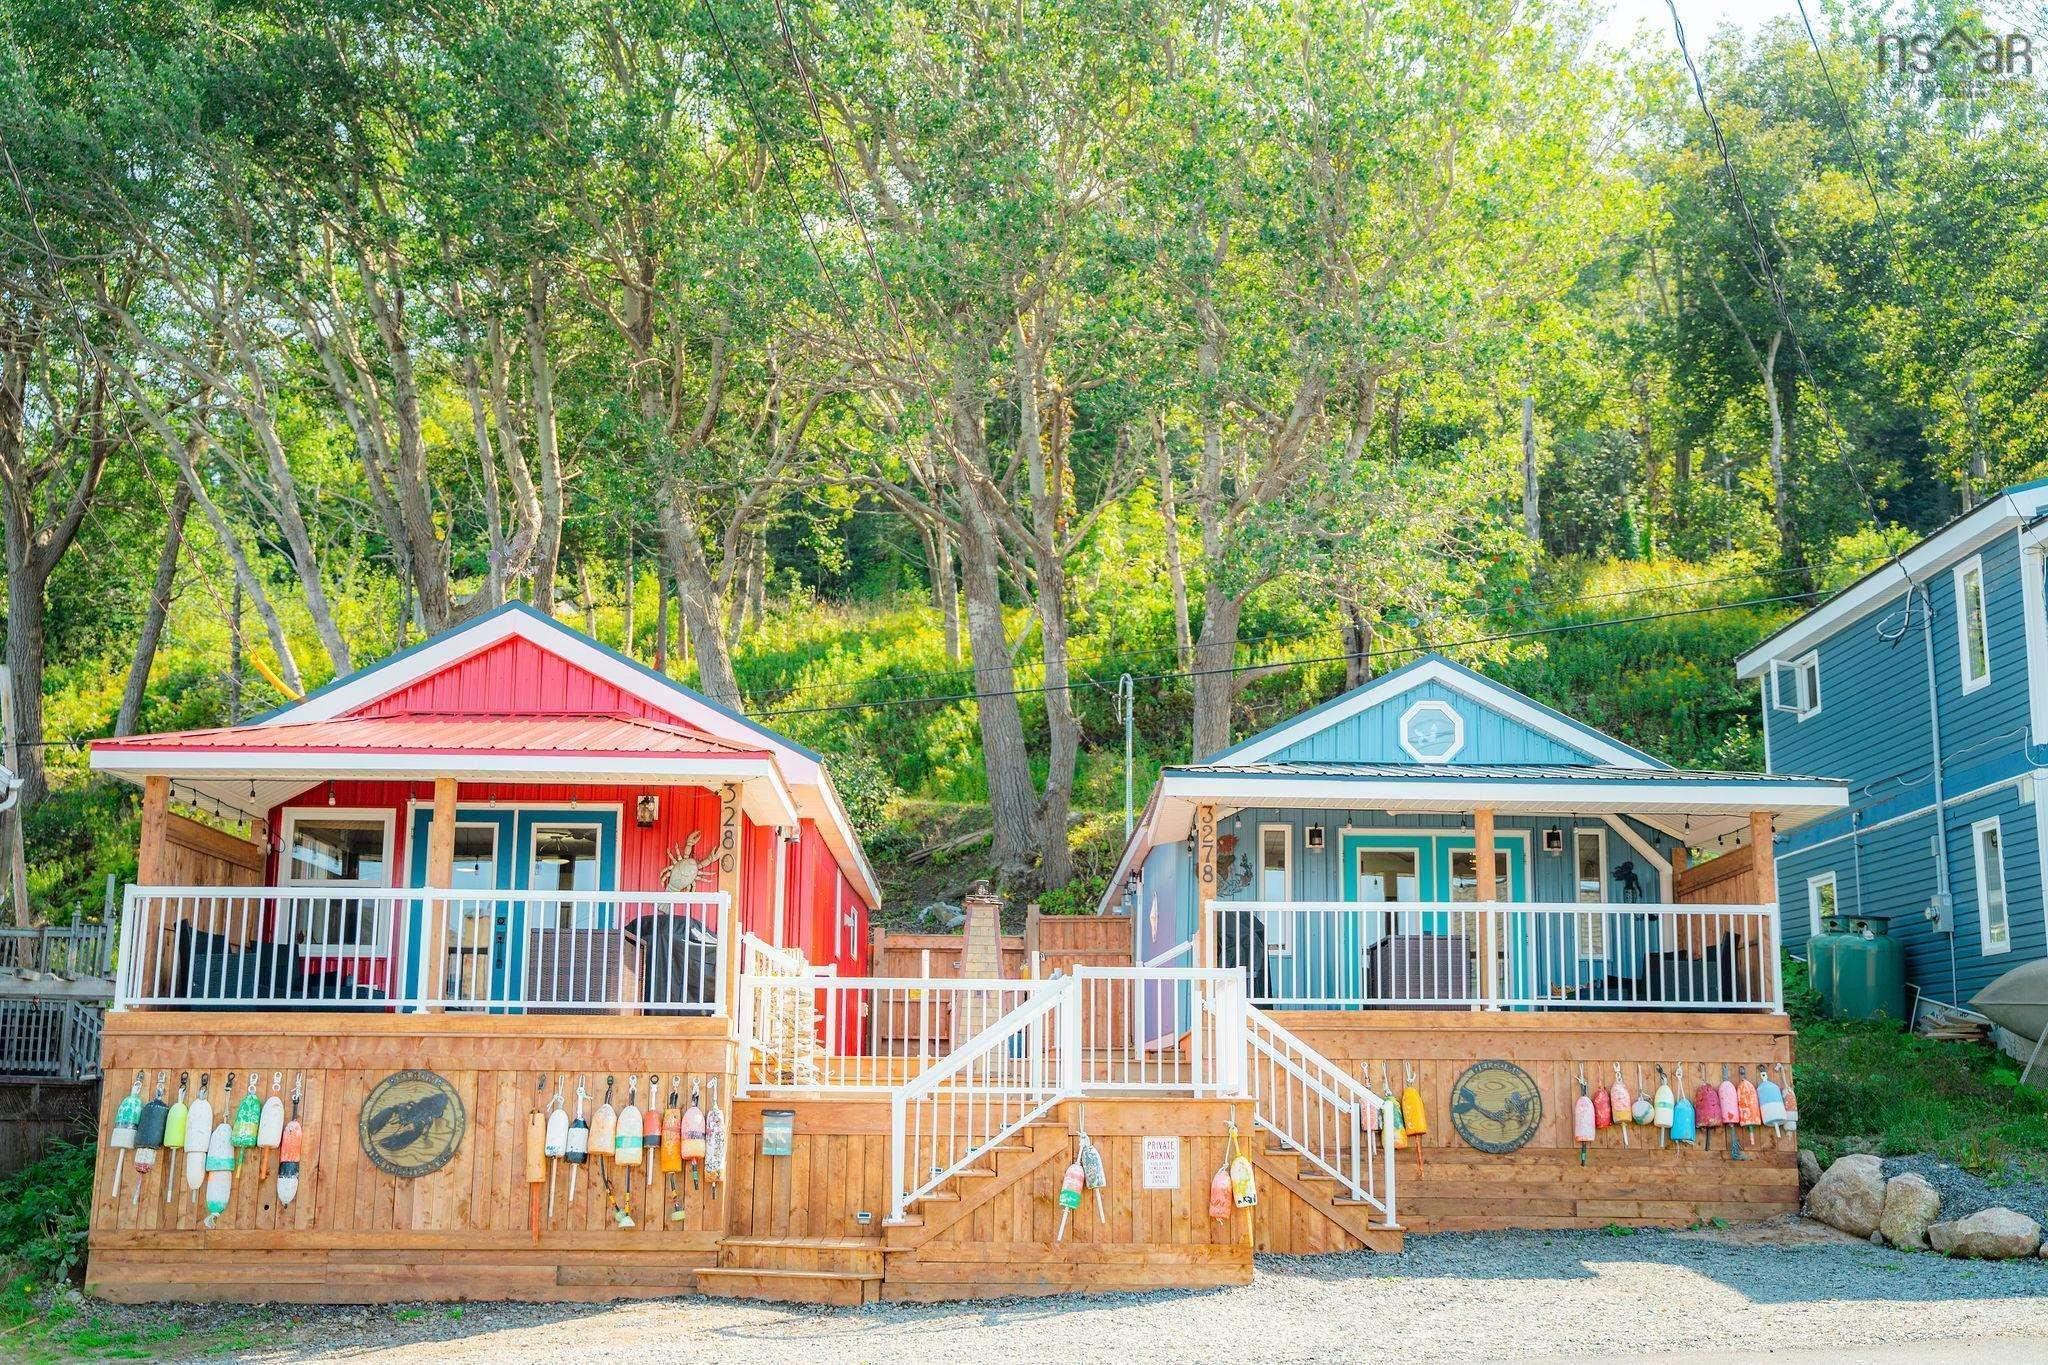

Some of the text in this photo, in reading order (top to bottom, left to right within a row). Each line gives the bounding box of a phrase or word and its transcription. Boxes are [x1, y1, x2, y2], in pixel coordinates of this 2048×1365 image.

[721, 783, 737, 873] 3280
[1202, 805, 1214, 883] 3278
[1146, 1151, 1175, 1160] PARKING
[1147, 1141, 1175, 1150] PRIVATE
